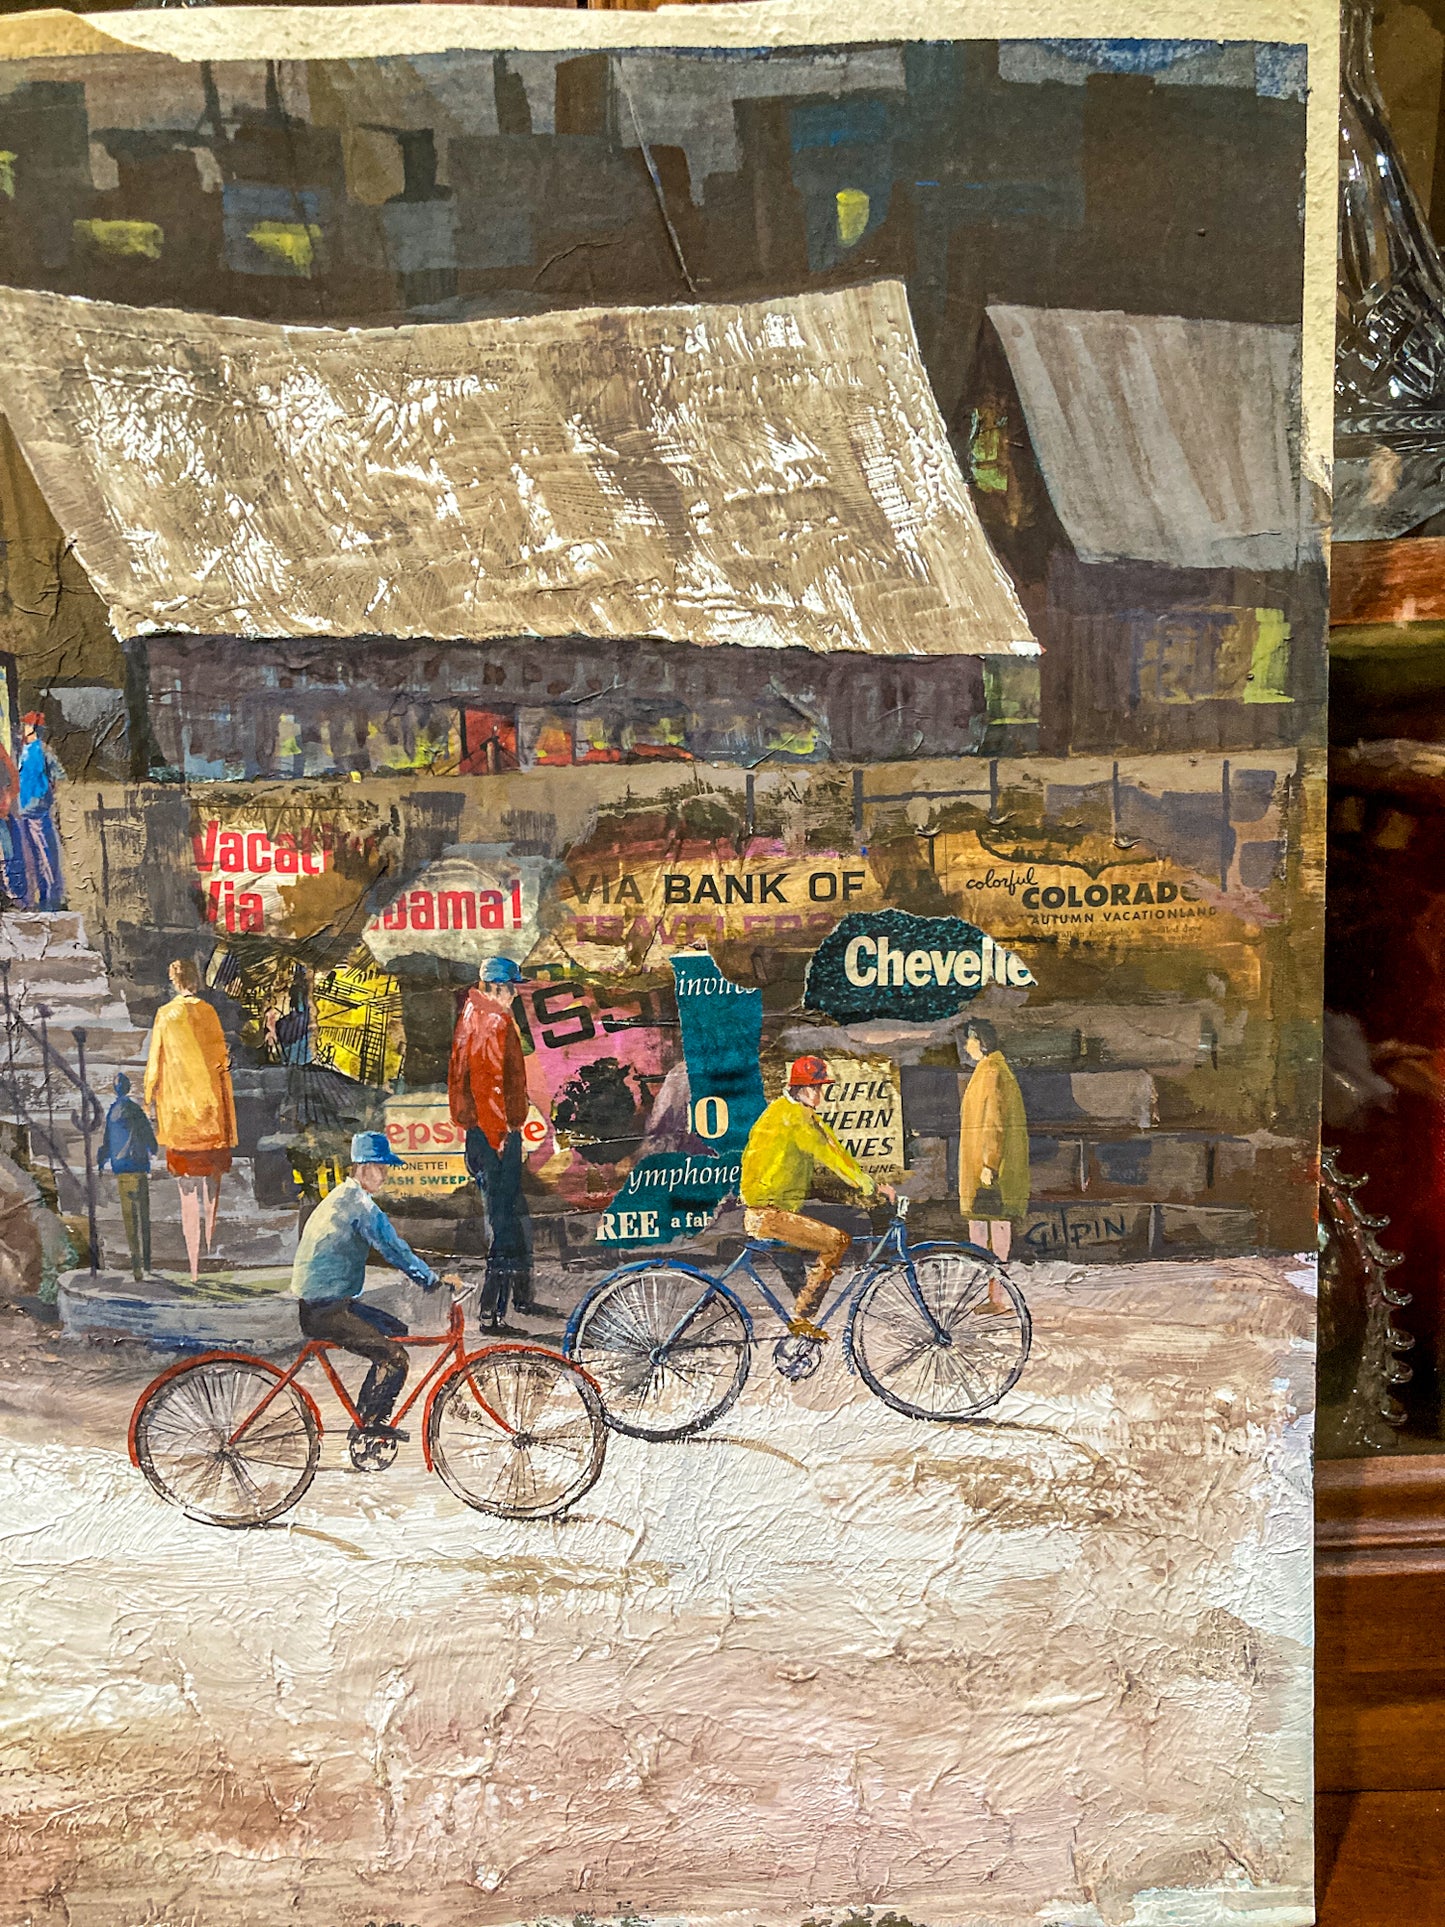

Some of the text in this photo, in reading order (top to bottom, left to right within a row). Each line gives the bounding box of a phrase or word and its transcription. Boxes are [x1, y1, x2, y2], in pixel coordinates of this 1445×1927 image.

[570, 873, 643, 904] VIA
[663, 873, 790, 904] BANK
[808, 870, 866, 902] OF
[966, 867, 1038, 896] colorful
[194, 880, 264, 932] Via
[1031, 905, 1218, 926] AUTUMN VACATIONLAND
[844, 936, 1038, 987] Chevelle
[869, 1164, 897, 1174] LINE
[671, 1216, 681, 1229] a
